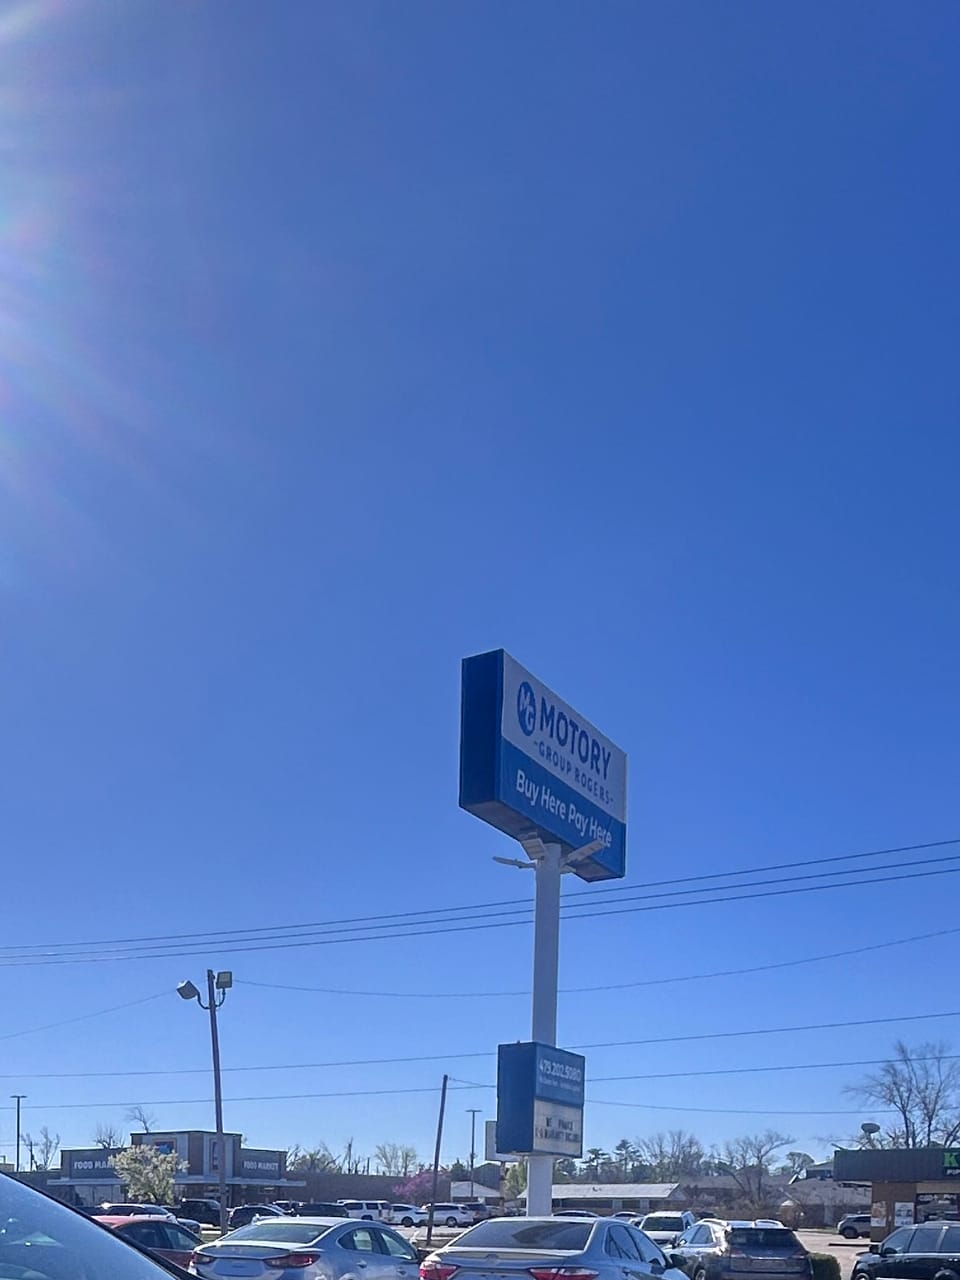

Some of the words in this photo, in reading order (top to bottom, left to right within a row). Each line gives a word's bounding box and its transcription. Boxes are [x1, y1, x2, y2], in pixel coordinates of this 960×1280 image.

[540, 696, 611, 780] MOTORY
[516, 769, 538, 806] Buy
[541, 785, 566, 819] Here
[568, 804, 589, 838] Pay
[589, 816, 613, 848] Here
[74, 1161, 93, 1169] FOOD
[243, 1160, 257, 1169] FOOD
